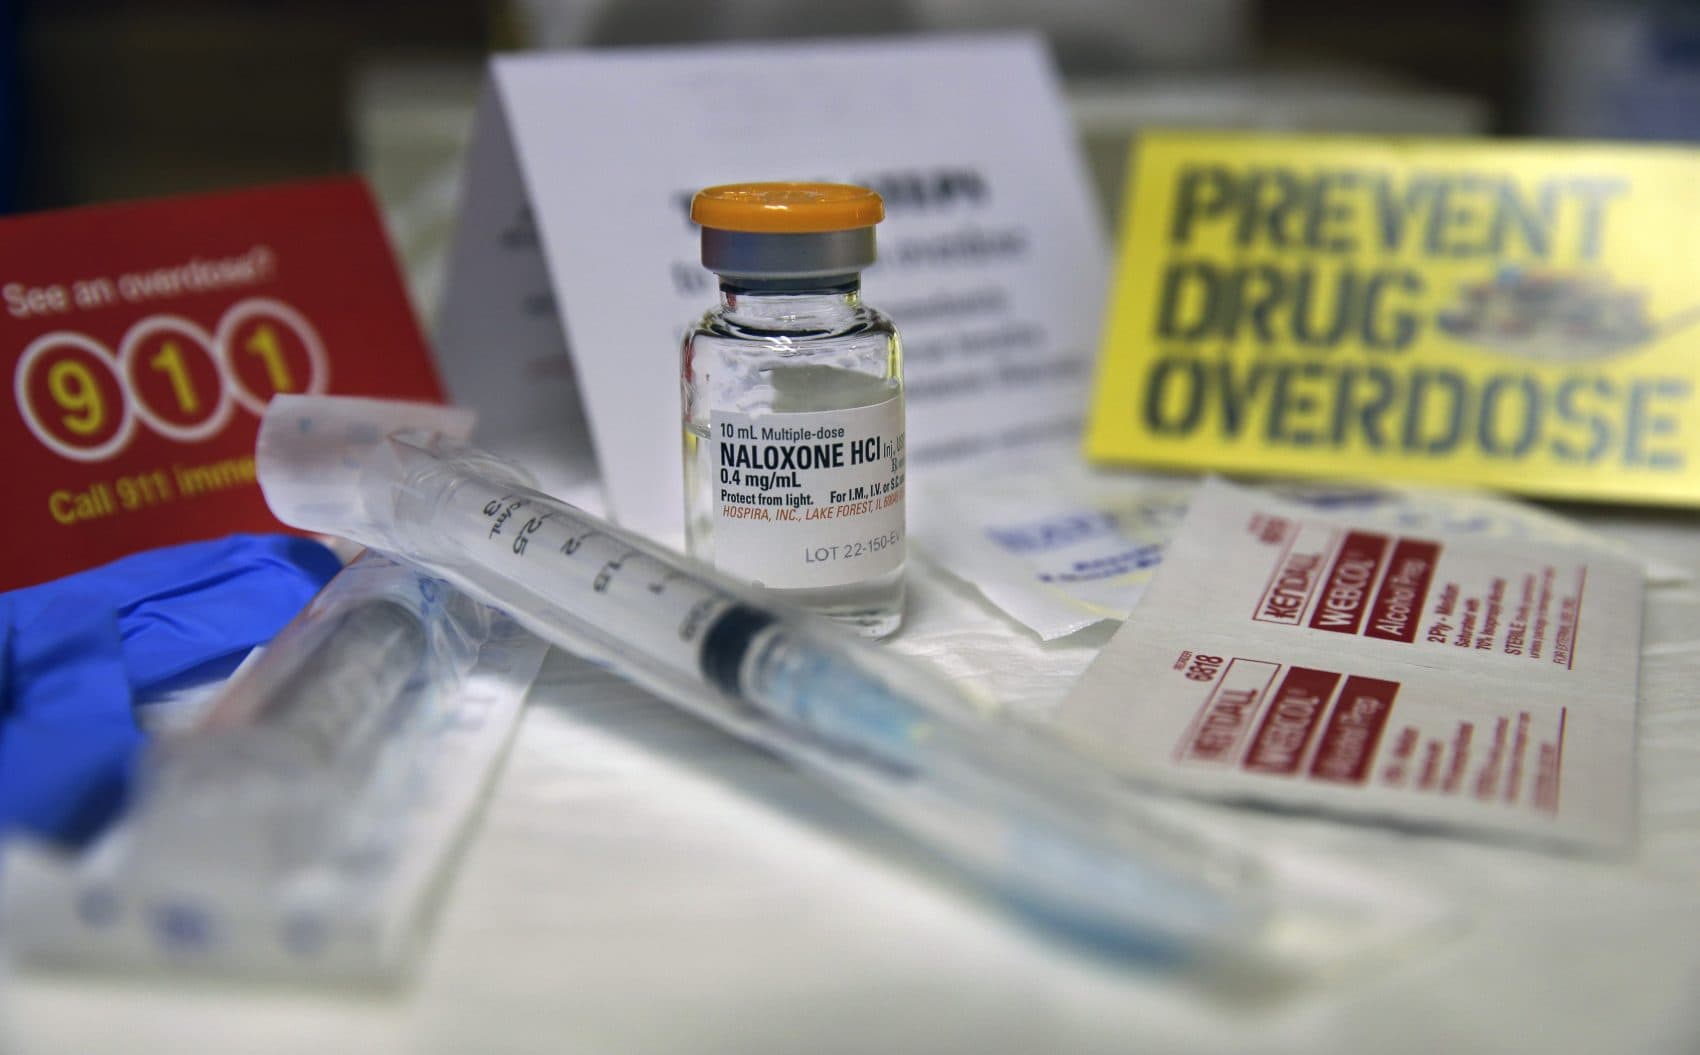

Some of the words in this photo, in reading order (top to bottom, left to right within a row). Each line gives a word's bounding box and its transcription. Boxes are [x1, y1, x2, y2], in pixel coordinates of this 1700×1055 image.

[1173, 163, 1632, 260] PREVENT
[2, 282, 68, 317] See
[73, 276, 115, 310] an
[1155, 262, 1428, 352] DRUG
[1143, 355, 1692, 470] OVERDOSE
[720, 422, 735, 439] 10
[737, 425, 758, 440] mL
[761, 427, 845, 443] Multiple-dose
[720, 442, 844, 470] NALOXONE
[720, 468, 741, 485] 0.4
[745, 471, 801, 490] mg/mL
[48, 481, 116, 525] Call
[117, 473, 170, 510] 911
[721, 489, 755, 504] Protect
[758, 492, 783, 505] from
[786, 493, 814, 508] light.
[830, 491, 846, 503] For
[883, 483, 890, 493] or
[723, 504, 772, 522] HOSPIRA,
[775, 508, 801, 522] INC.,
[805, 505, 834, 520] LAKE
[836, 500, 873, 517] FOREST,
[805, 547, 838, 563] LOT
[1376, 586, 1415, 636] Alcohol
[1504, 622, 1527, 655] STERILE
[1185, 654, 1224, 682] 6818
